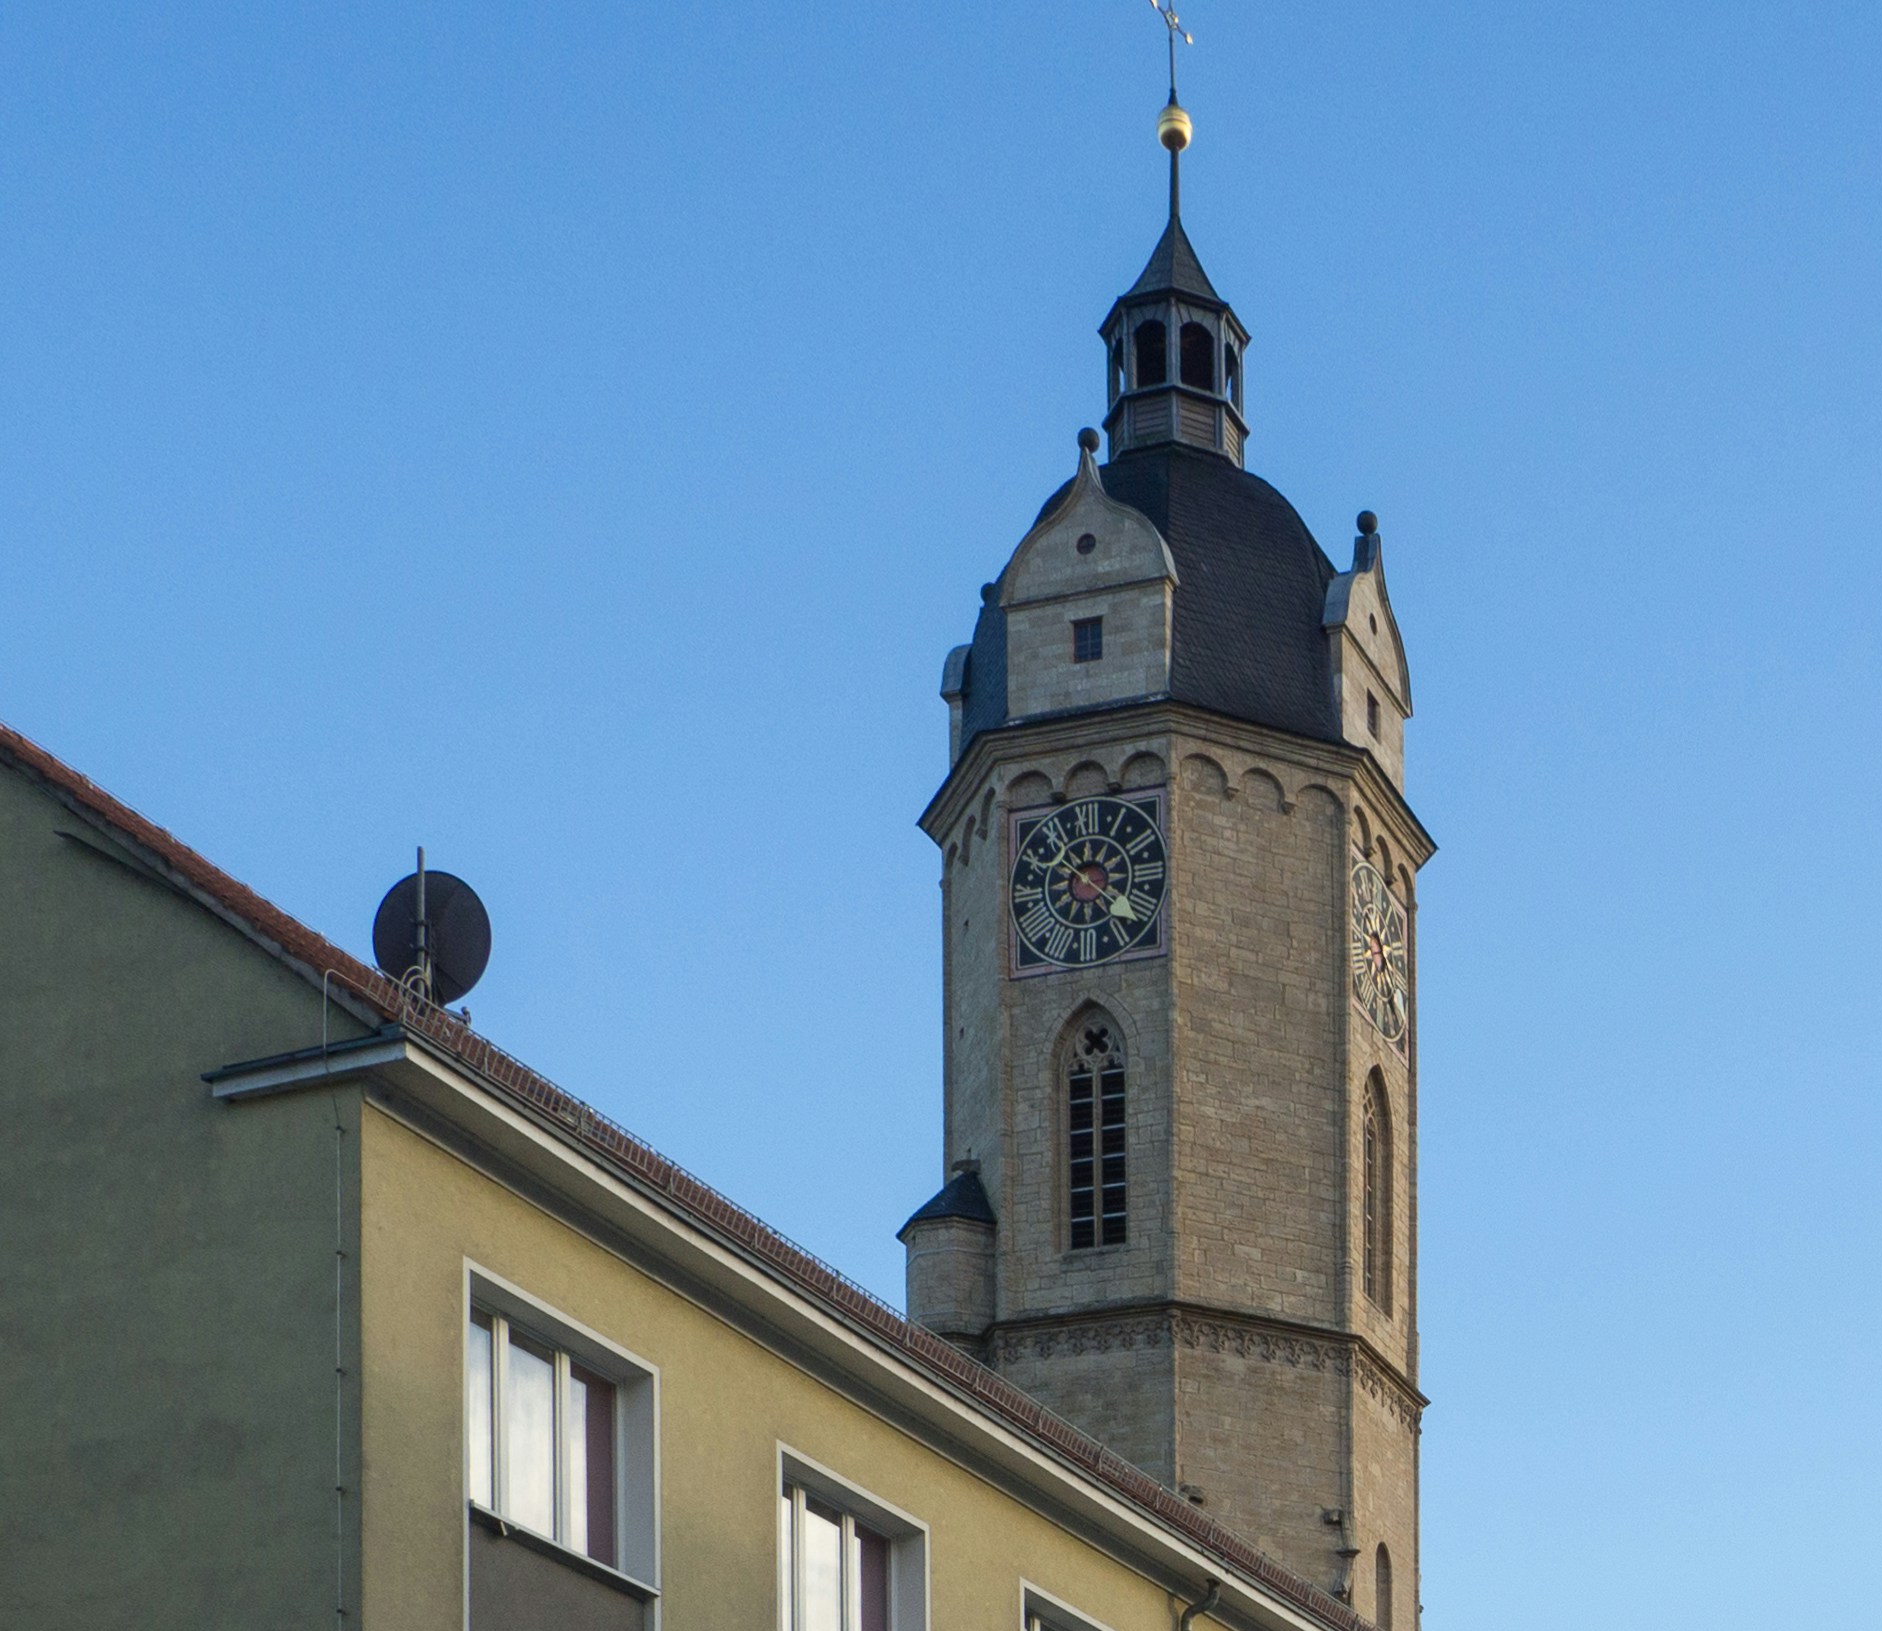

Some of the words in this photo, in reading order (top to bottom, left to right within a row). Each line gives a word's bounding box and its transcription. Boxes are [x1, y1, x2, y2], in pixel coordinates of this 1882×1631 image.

[1074, 802, 1099, 837] XII
[1110, 807, 1126, 836] I
[1126, 829, 1156, 855] II
[1134, 861, 1163, 883] III
